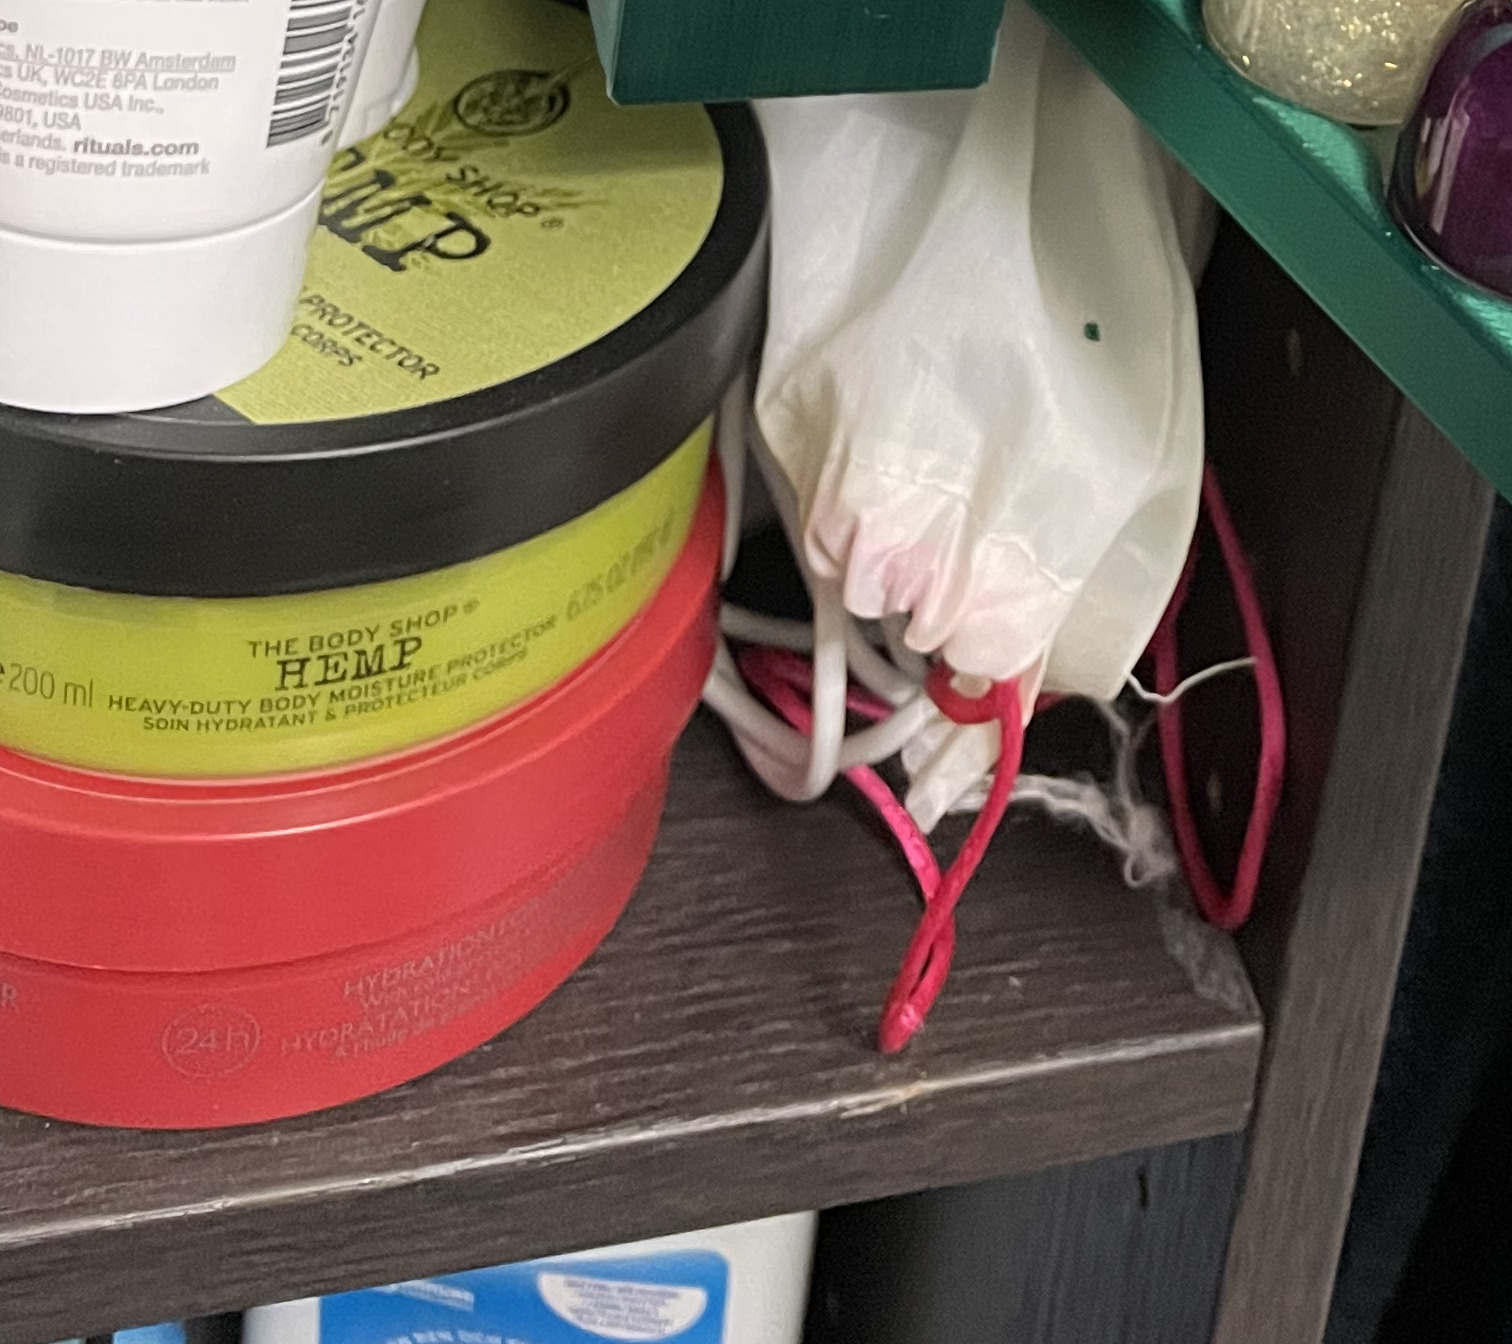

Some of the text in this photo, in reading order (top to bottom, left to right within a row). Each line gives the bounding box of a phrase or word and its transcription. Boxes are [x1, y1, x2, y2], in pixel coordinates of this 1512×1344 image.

[17, 65, 48, 87] UK,
[54, 68, 107, 89] WC2E
[112, 73, 148, 91] 6PA
[152, 73, 220, 91] London
[25, 43, 96, 65] NL-1017
[100, 49, 132, 68] BW
[134, 51, 237, 72] Amsterdam
[43, 111, 82, 131] USA
[83, 93, 124, 112] USA
[27, 157, 118, 177] registered
[121, 158, 211, 177] trademark
[73, 138, 200, 156] rituals.com
[383, 122, 541, 220] ODY SHOP
[318, 147, 491, 272] MP
[290, 323, 364, 367] CORPS
[299, 293, 441, 381] PROTECTOR
[248, 603, 459, 658] THE BODY SHOP
[9, 661, 95, 709] 200 ml
[108, 613, 557, 716] HEAVY-DUTY BODY MOISTURE PROTECTOR
[275, 635, 423, 693] HEMP
[143, 716, 190, 733] SOIN
[196, 711, 317, 733] HYDRATANT
[344, 670, 467, 718] PROTECTEUR
